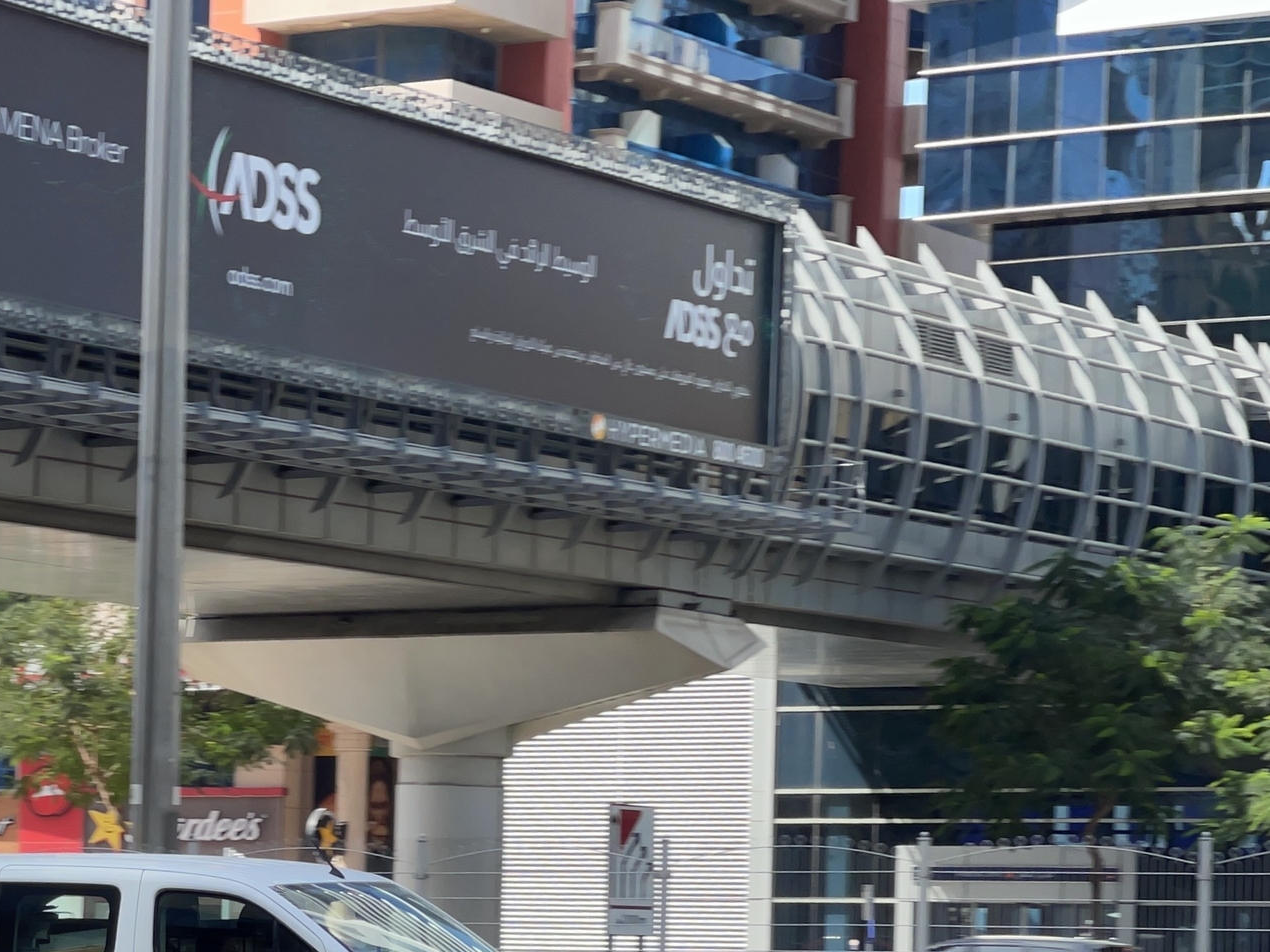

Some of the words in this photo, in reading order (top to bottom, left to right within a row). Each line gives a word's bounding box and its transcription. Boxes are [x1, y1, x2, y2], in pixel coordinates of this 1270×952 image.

[65, 124, 129, 164] Broker
[218, 151, 322, 235] ADSS
[226, 266, 294, 297] adss.com
[692, 244, 756, 301] تداول
[663, 298, 722, 350] ADSS
[721, 312, 755, 358] مع
[606, 418, 709, 458] HYPERMEDIA
[176, 810, 264, 841] rdee's
